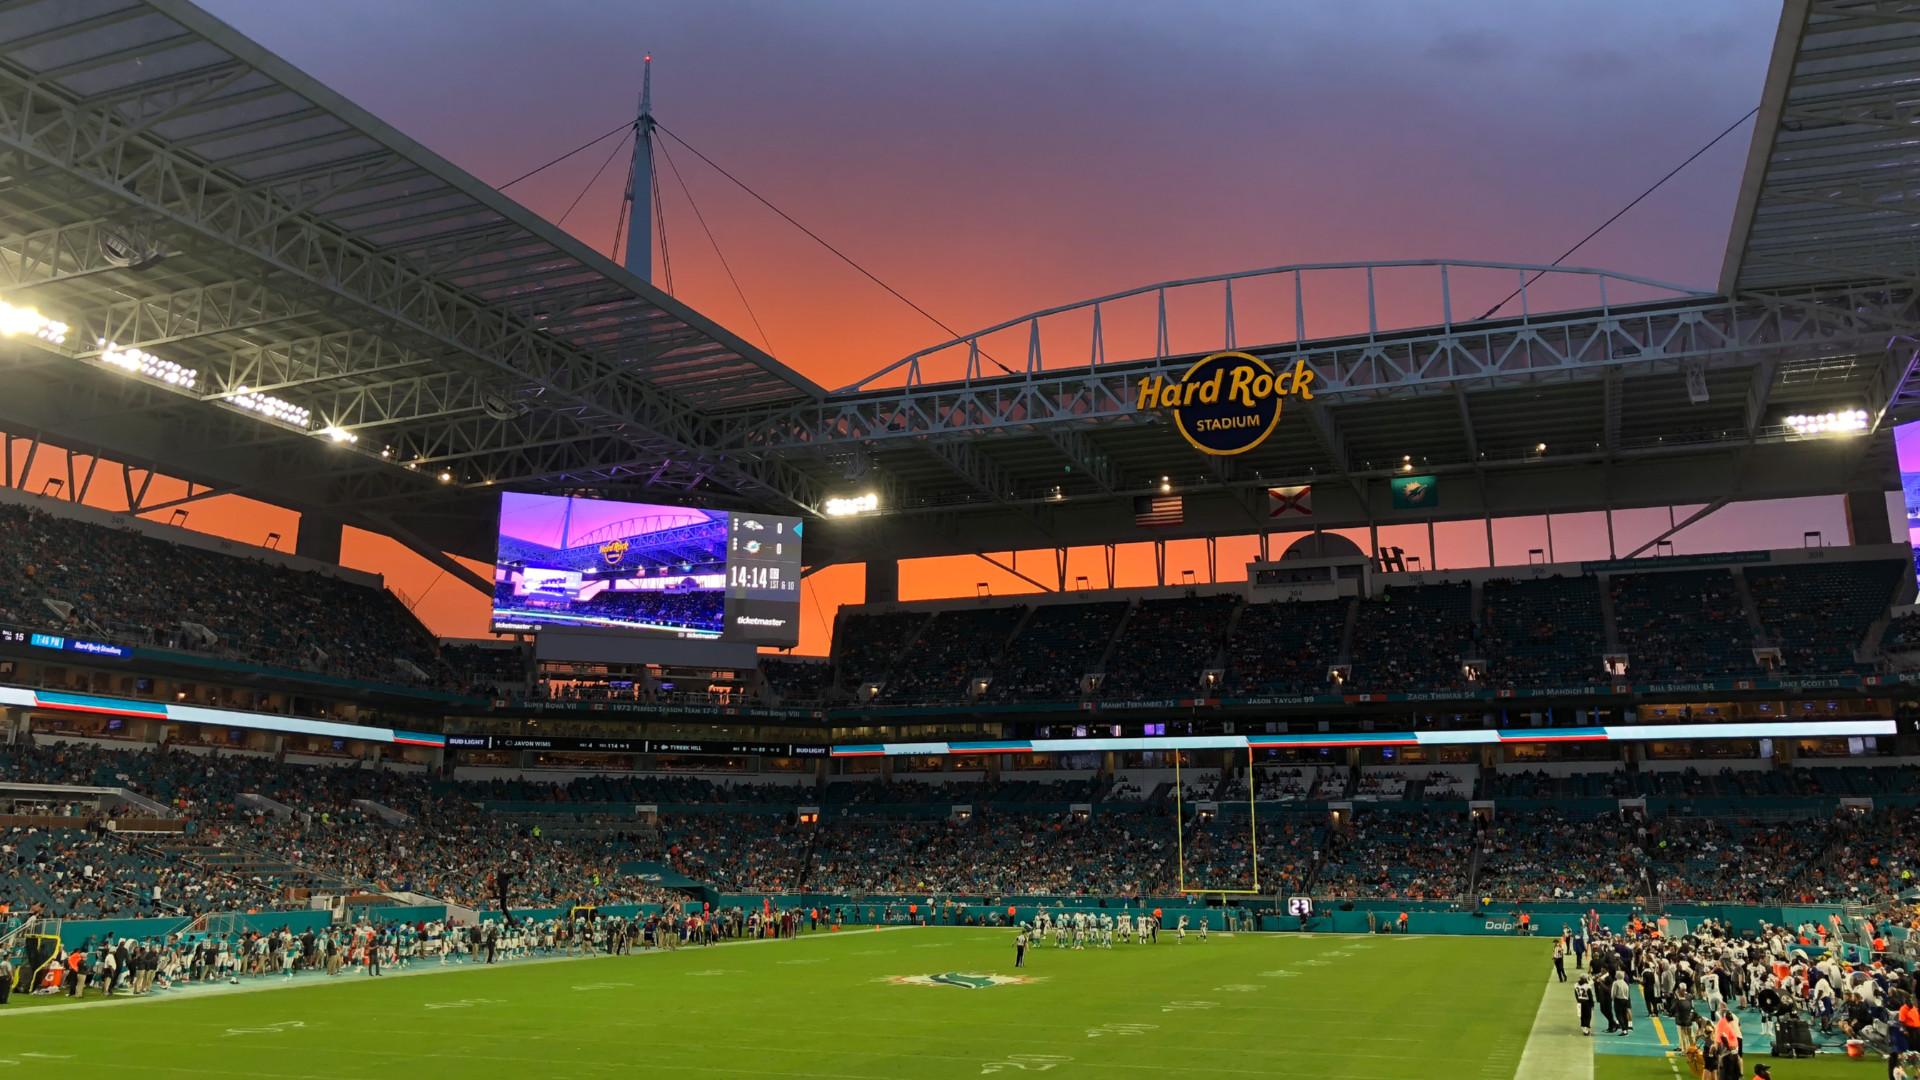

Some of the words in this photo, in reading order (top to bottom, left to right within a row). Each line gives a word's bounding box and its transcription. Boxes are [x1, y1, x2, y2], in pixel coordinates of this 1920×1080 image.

[1136, 368, 1224, 410] Hard
[1228, 359, 1316, 408] Rock
[1196, 414, 1261, 432] STADIUM
[777, 522, 782, 534] 0
[776, 543, 782, 554] 0
[731, 566, 767, 588] 14:14
[737, 616, 786, 626] ticketmaster
[15, 632, 24, 642] 15
[1292, 900, 1308, 914] 23
[1485, 921, 1539, 932] Dolps
